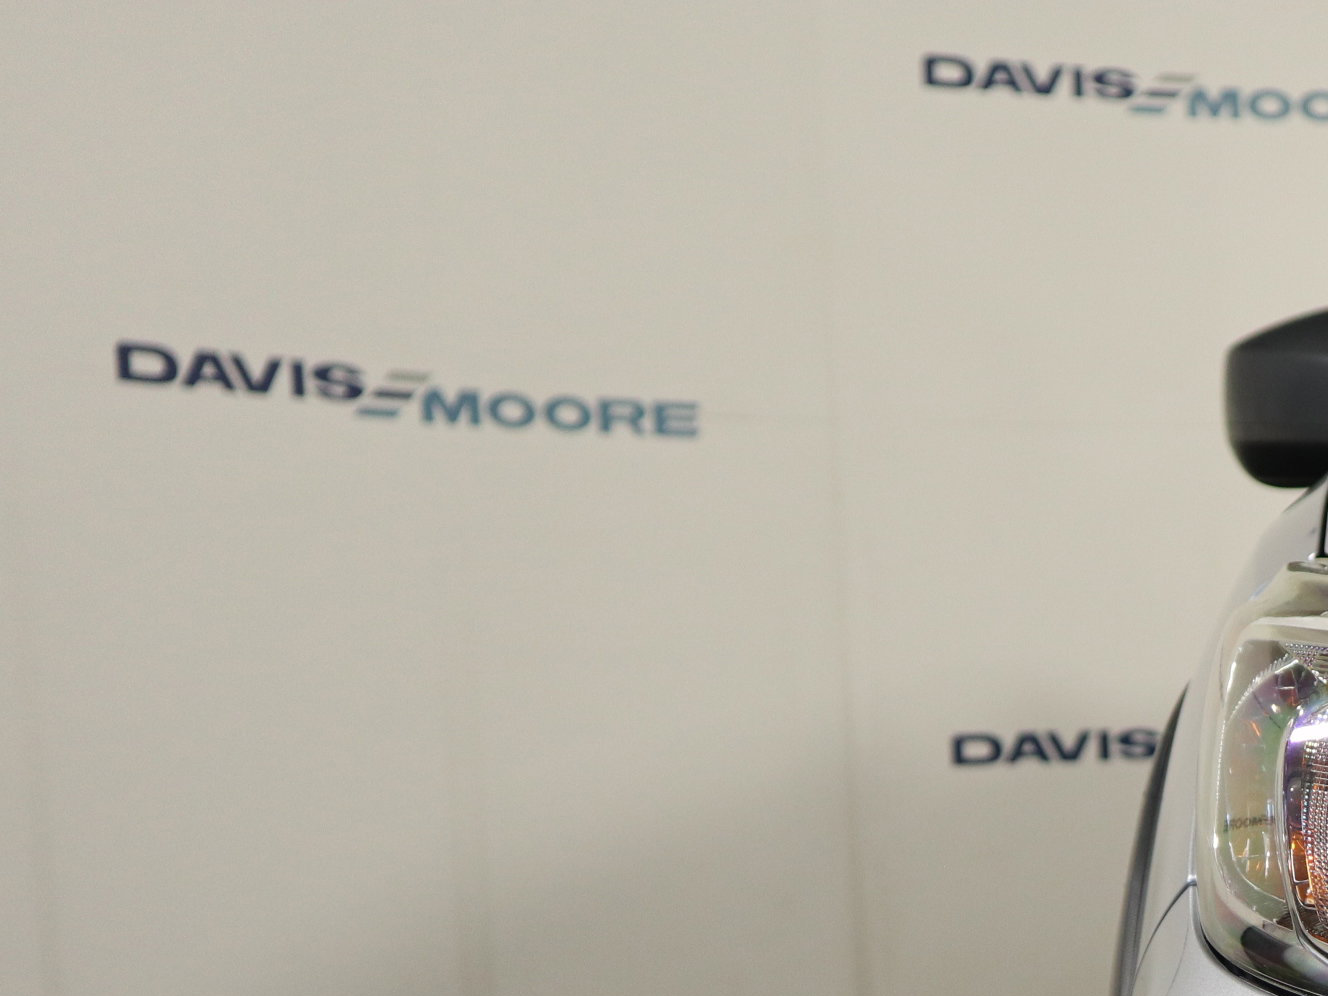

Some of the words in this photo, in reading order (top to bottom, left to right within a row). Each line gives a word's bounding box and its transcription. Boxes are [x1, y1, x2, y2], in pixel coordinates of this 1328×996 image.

[921, 53, 1137, 101] DAVIS
[115, 340, 367, 403] DAVIS
[421, 386, 700, 438] MOORE
[952, 728, 1158, 766] DAVIS
